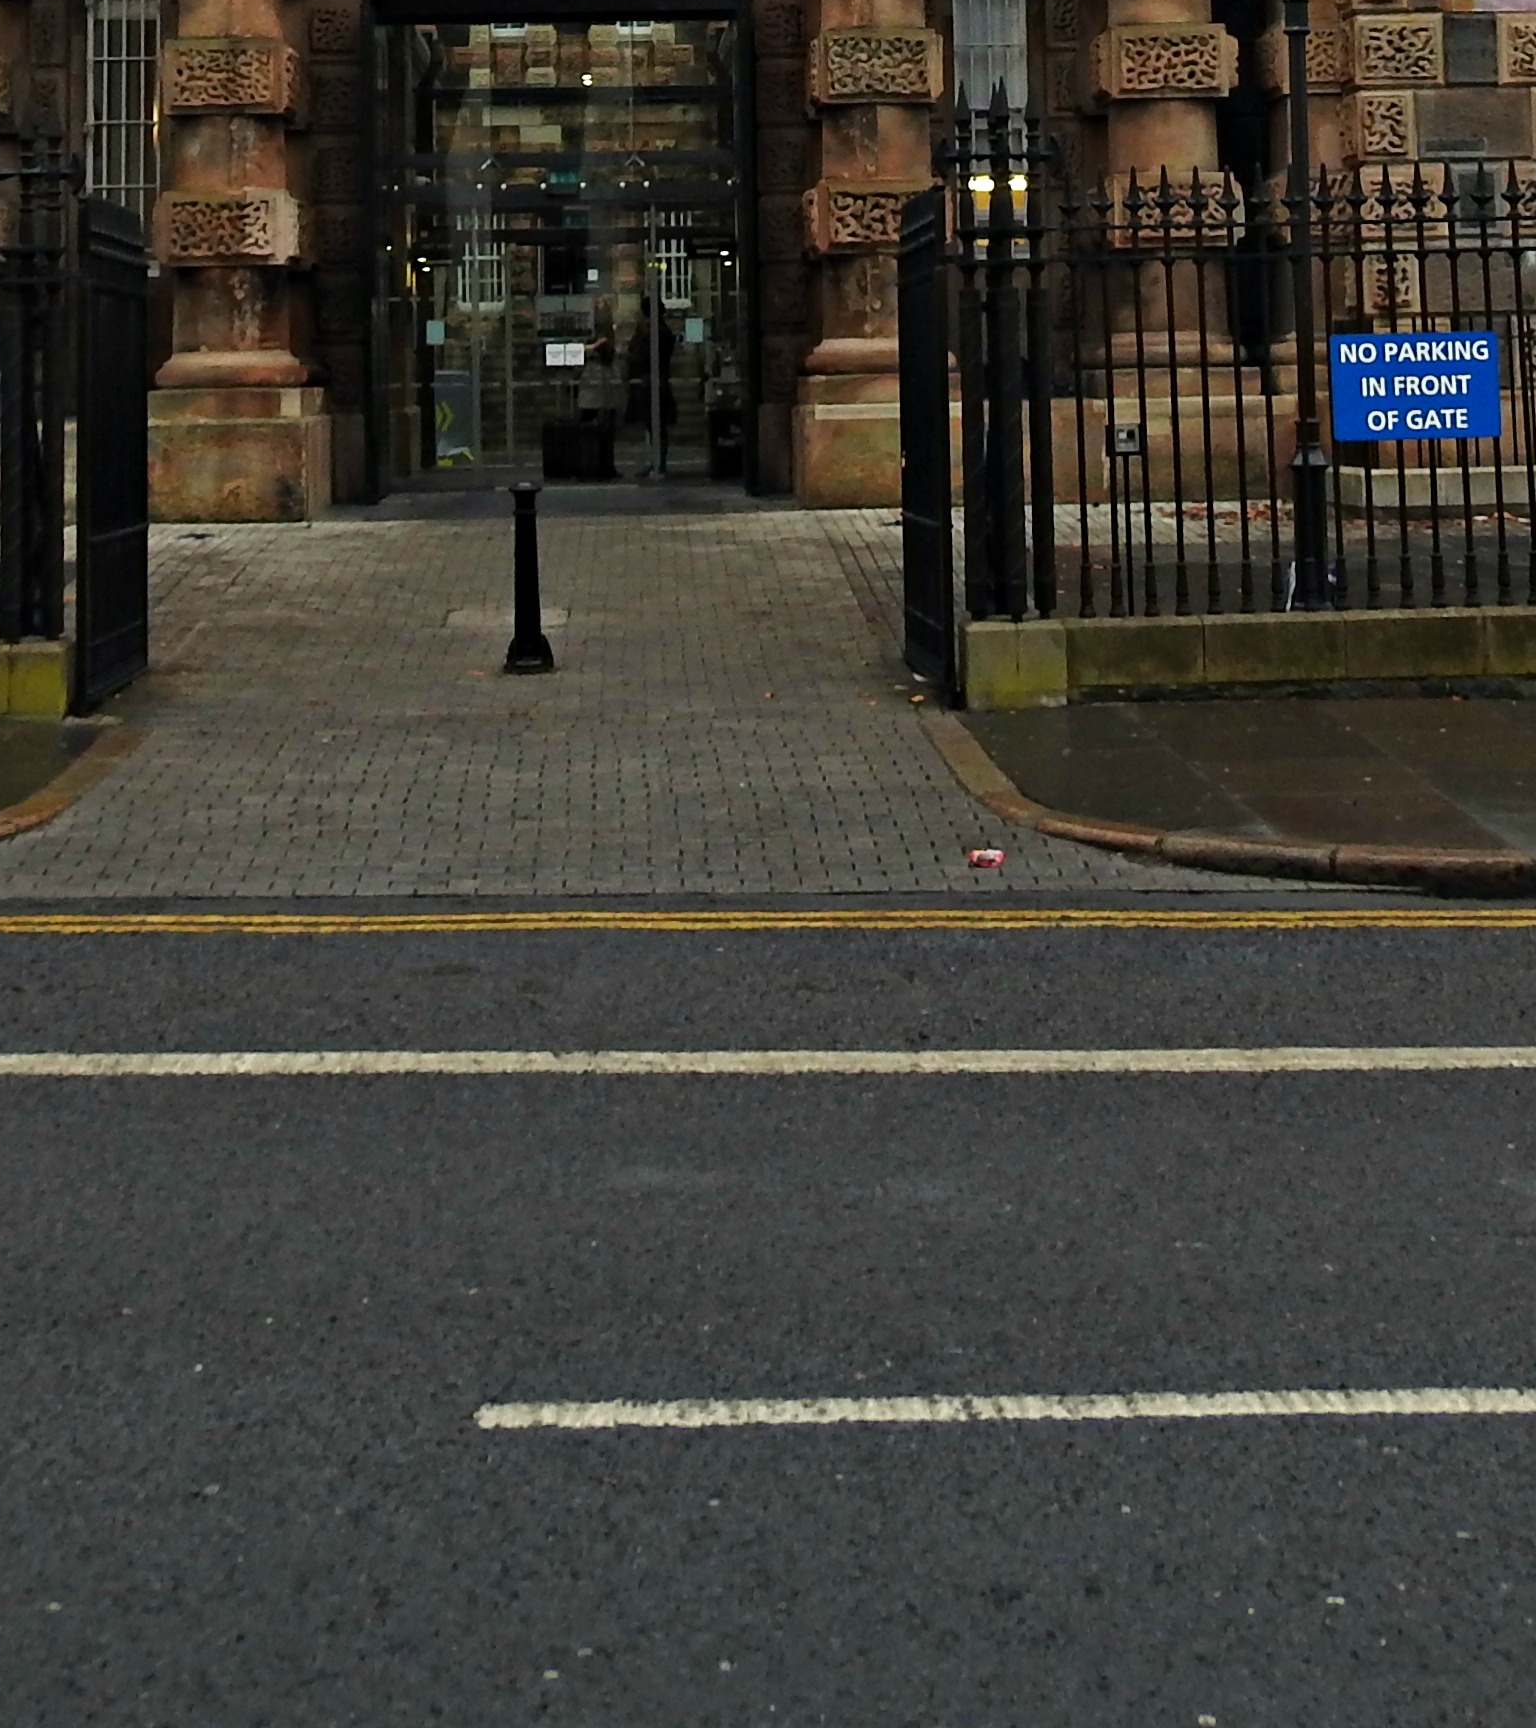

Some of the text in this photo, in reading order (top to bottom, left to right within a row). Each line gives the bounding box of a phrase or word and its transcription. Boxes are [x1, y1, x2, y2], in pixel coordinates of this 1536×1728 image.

[1340, 340, 1489, 364] NO PARKING
[1361, 374, 1472, 397] IN FRONT
[1367, 408, 1469, 431] OF GATE
